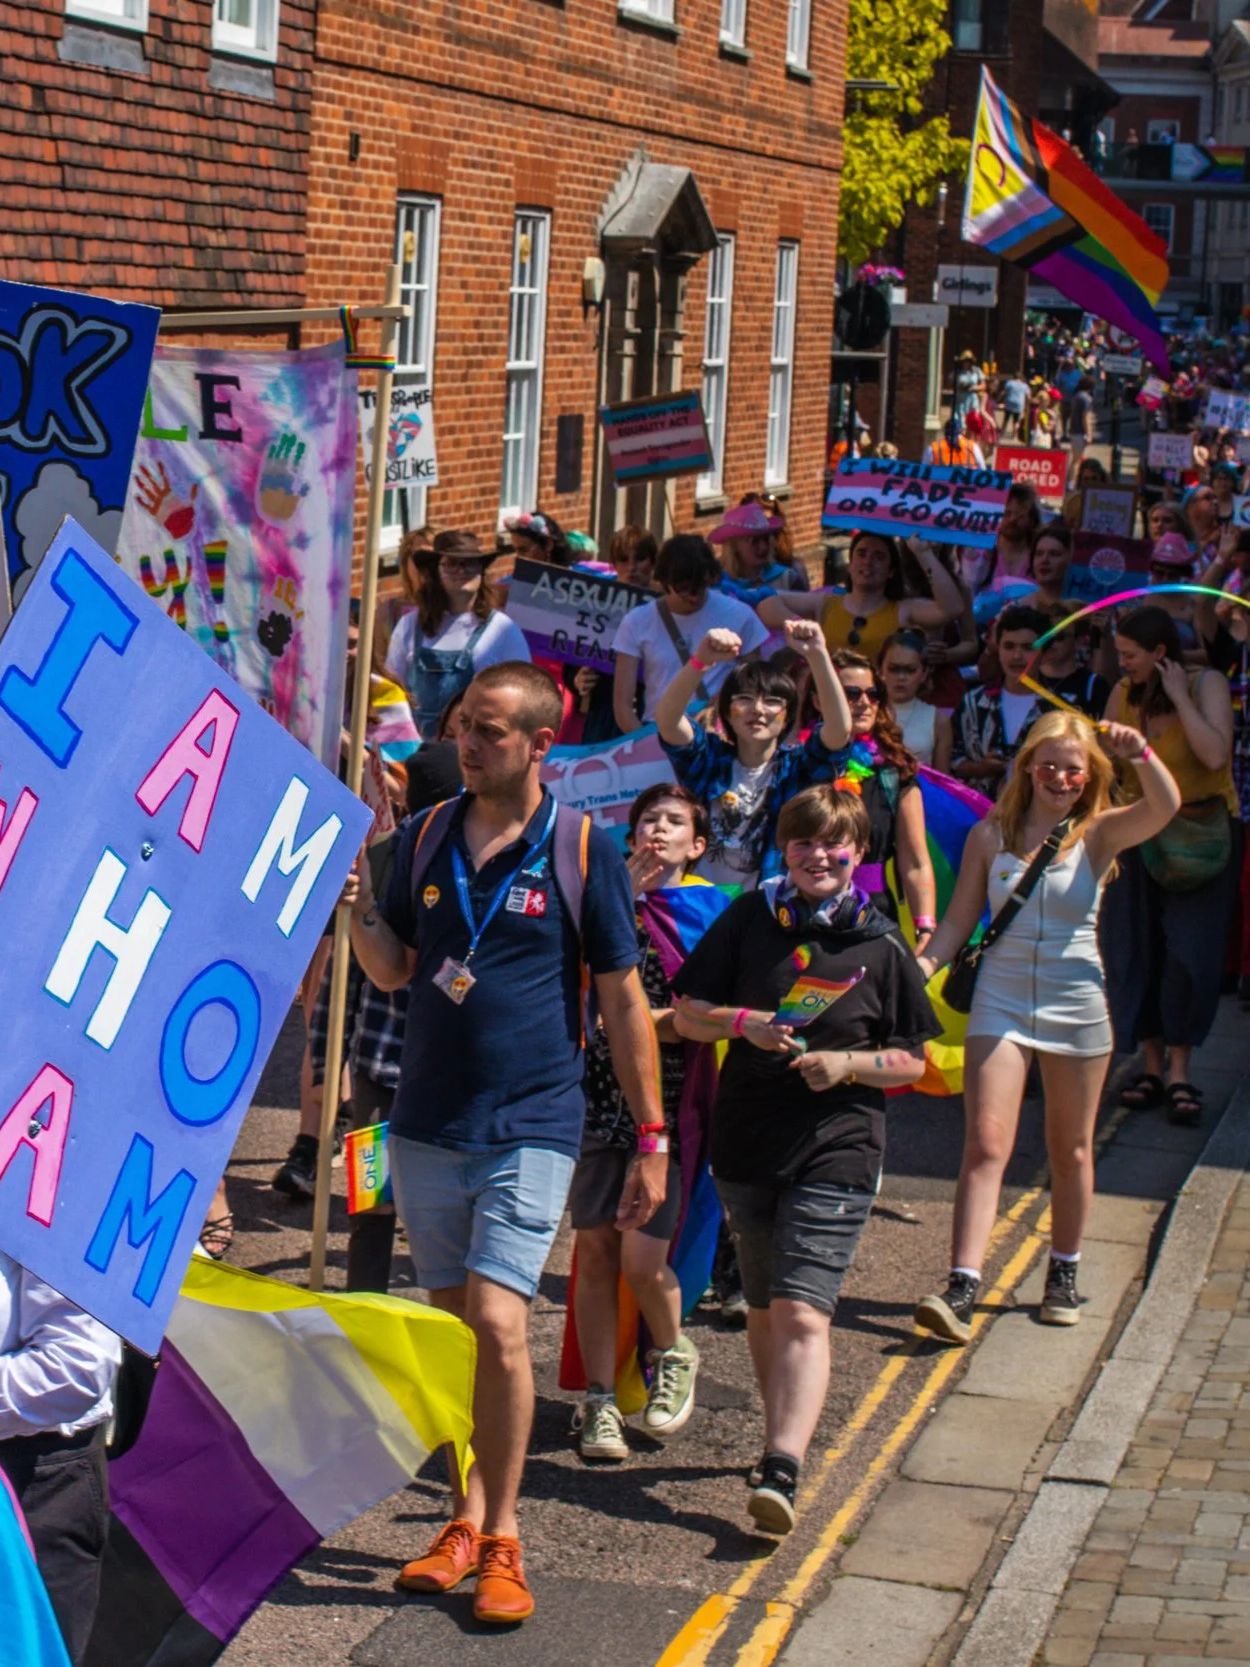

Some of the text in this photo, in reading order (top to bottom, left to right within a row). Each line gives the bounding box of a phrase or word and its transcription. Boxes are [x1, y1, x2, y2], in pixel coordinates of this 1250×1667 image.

[1009, 458, 1052, 473] ROAD
[950, 467, 1014, 491] NOT
[881, 479, 977, 508] FADE
[837, 497, 878, 513] OR
[890, 501, 932, 522] GO
[576, 611, 610, 634] IS
[587, 792, 618, 805] Trans
[363, 1142, 377, 1190] ONE
